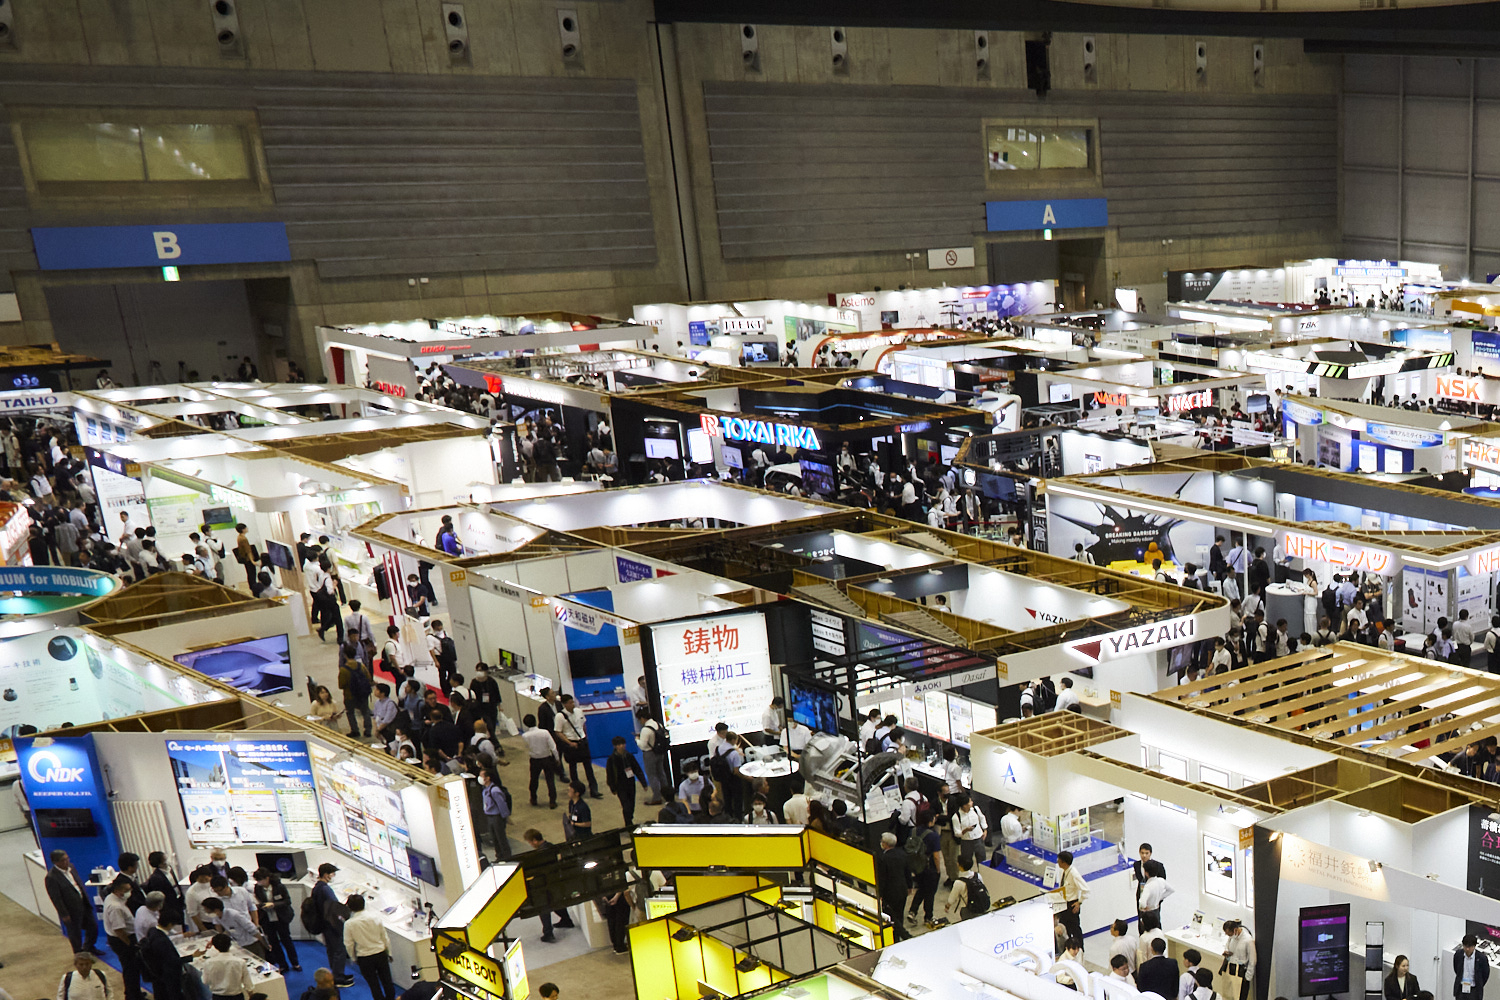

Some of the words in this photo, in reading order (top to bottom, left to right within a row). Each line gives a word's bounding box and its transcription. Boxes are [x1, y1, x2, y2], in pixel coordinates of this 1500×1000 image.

[1043, 204, 1056, 225] A
[153, 232, 181, 259] B
[840, 297, 875, 308] Astemo
[724, 320, 763, 333] JTEKT
[421, 345, 446, 353] DENSO
[1094, 391, 1127, 406] NACHI
[1436, 376, 1480, 400] NSK
[1, 395, 58, 409] TAIHO
[1168, 388, 1213, 411] NACHI
[719, 416, 775, 445] TOKAI
[775, 422, 822, 451] RIKA
[1105, 531, 1132, 539] BREAKING
[1132, 529, 1160, 537] BARRIERS
[0, 574, 26, 586] UM
[30, 572, 48, 586] for
[52, 573, 98, 590] MOBILITY
[568, 607, 595, 626] 天和磁材
[683, 624, 739, 655] 鋳物
[1109, 617, 1196, 653] YAZAKI
[681, 662, 752, 686] 機械加工
[961, 670, 987, 683] Dasai
[922, 680, 942, 692] AOKI
[453, 795, 471, 870] DaikyoNishikawa
[993, 932, 1035, 955] OTICS
[446, 954, 473, 972] WATA
[472, 960, 497, 985] BOLT
